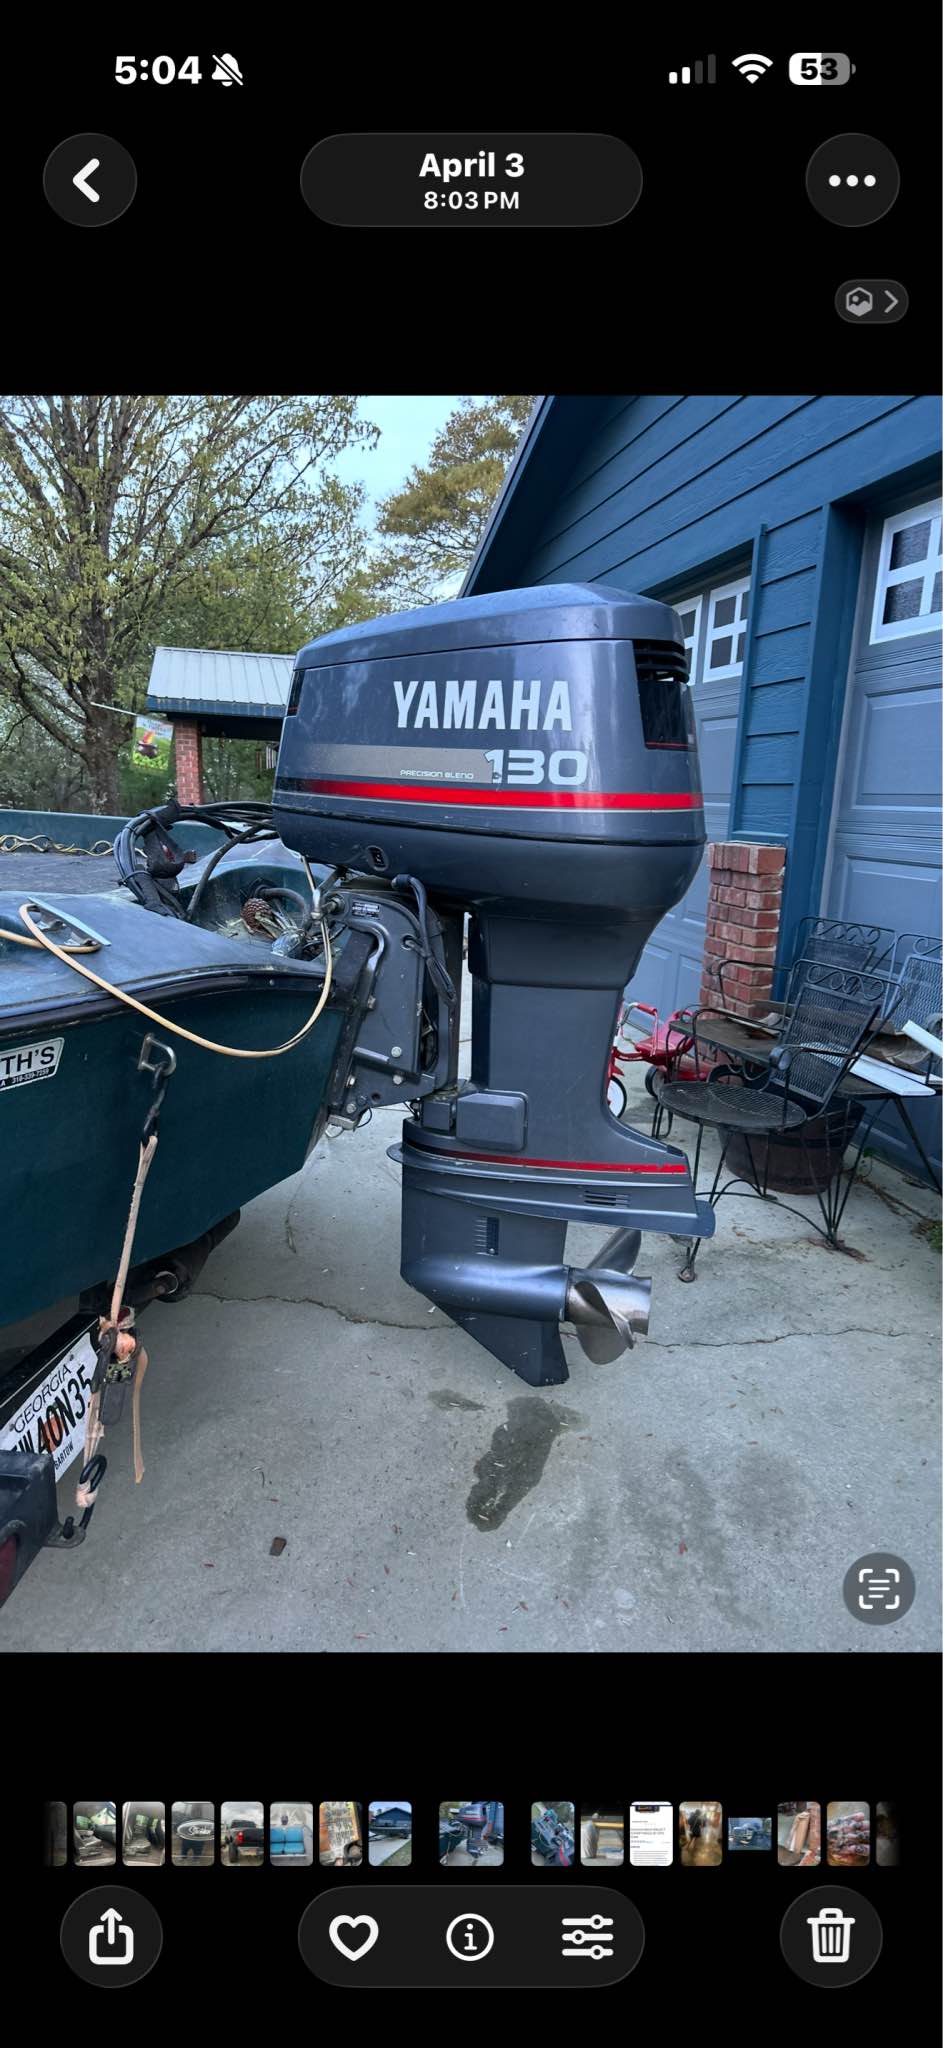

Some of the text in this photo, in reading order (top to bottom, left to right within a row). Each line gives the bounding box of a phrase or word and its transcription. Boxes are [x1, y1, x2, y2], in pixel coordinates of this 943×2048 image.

[393, 680, 572, 731] YAMAHA
[400, 769, 474, 780] PRECISION BLEND
[484, 749, 588, 786] 130
[14, 1364, 72, 1433] GEORGIA
